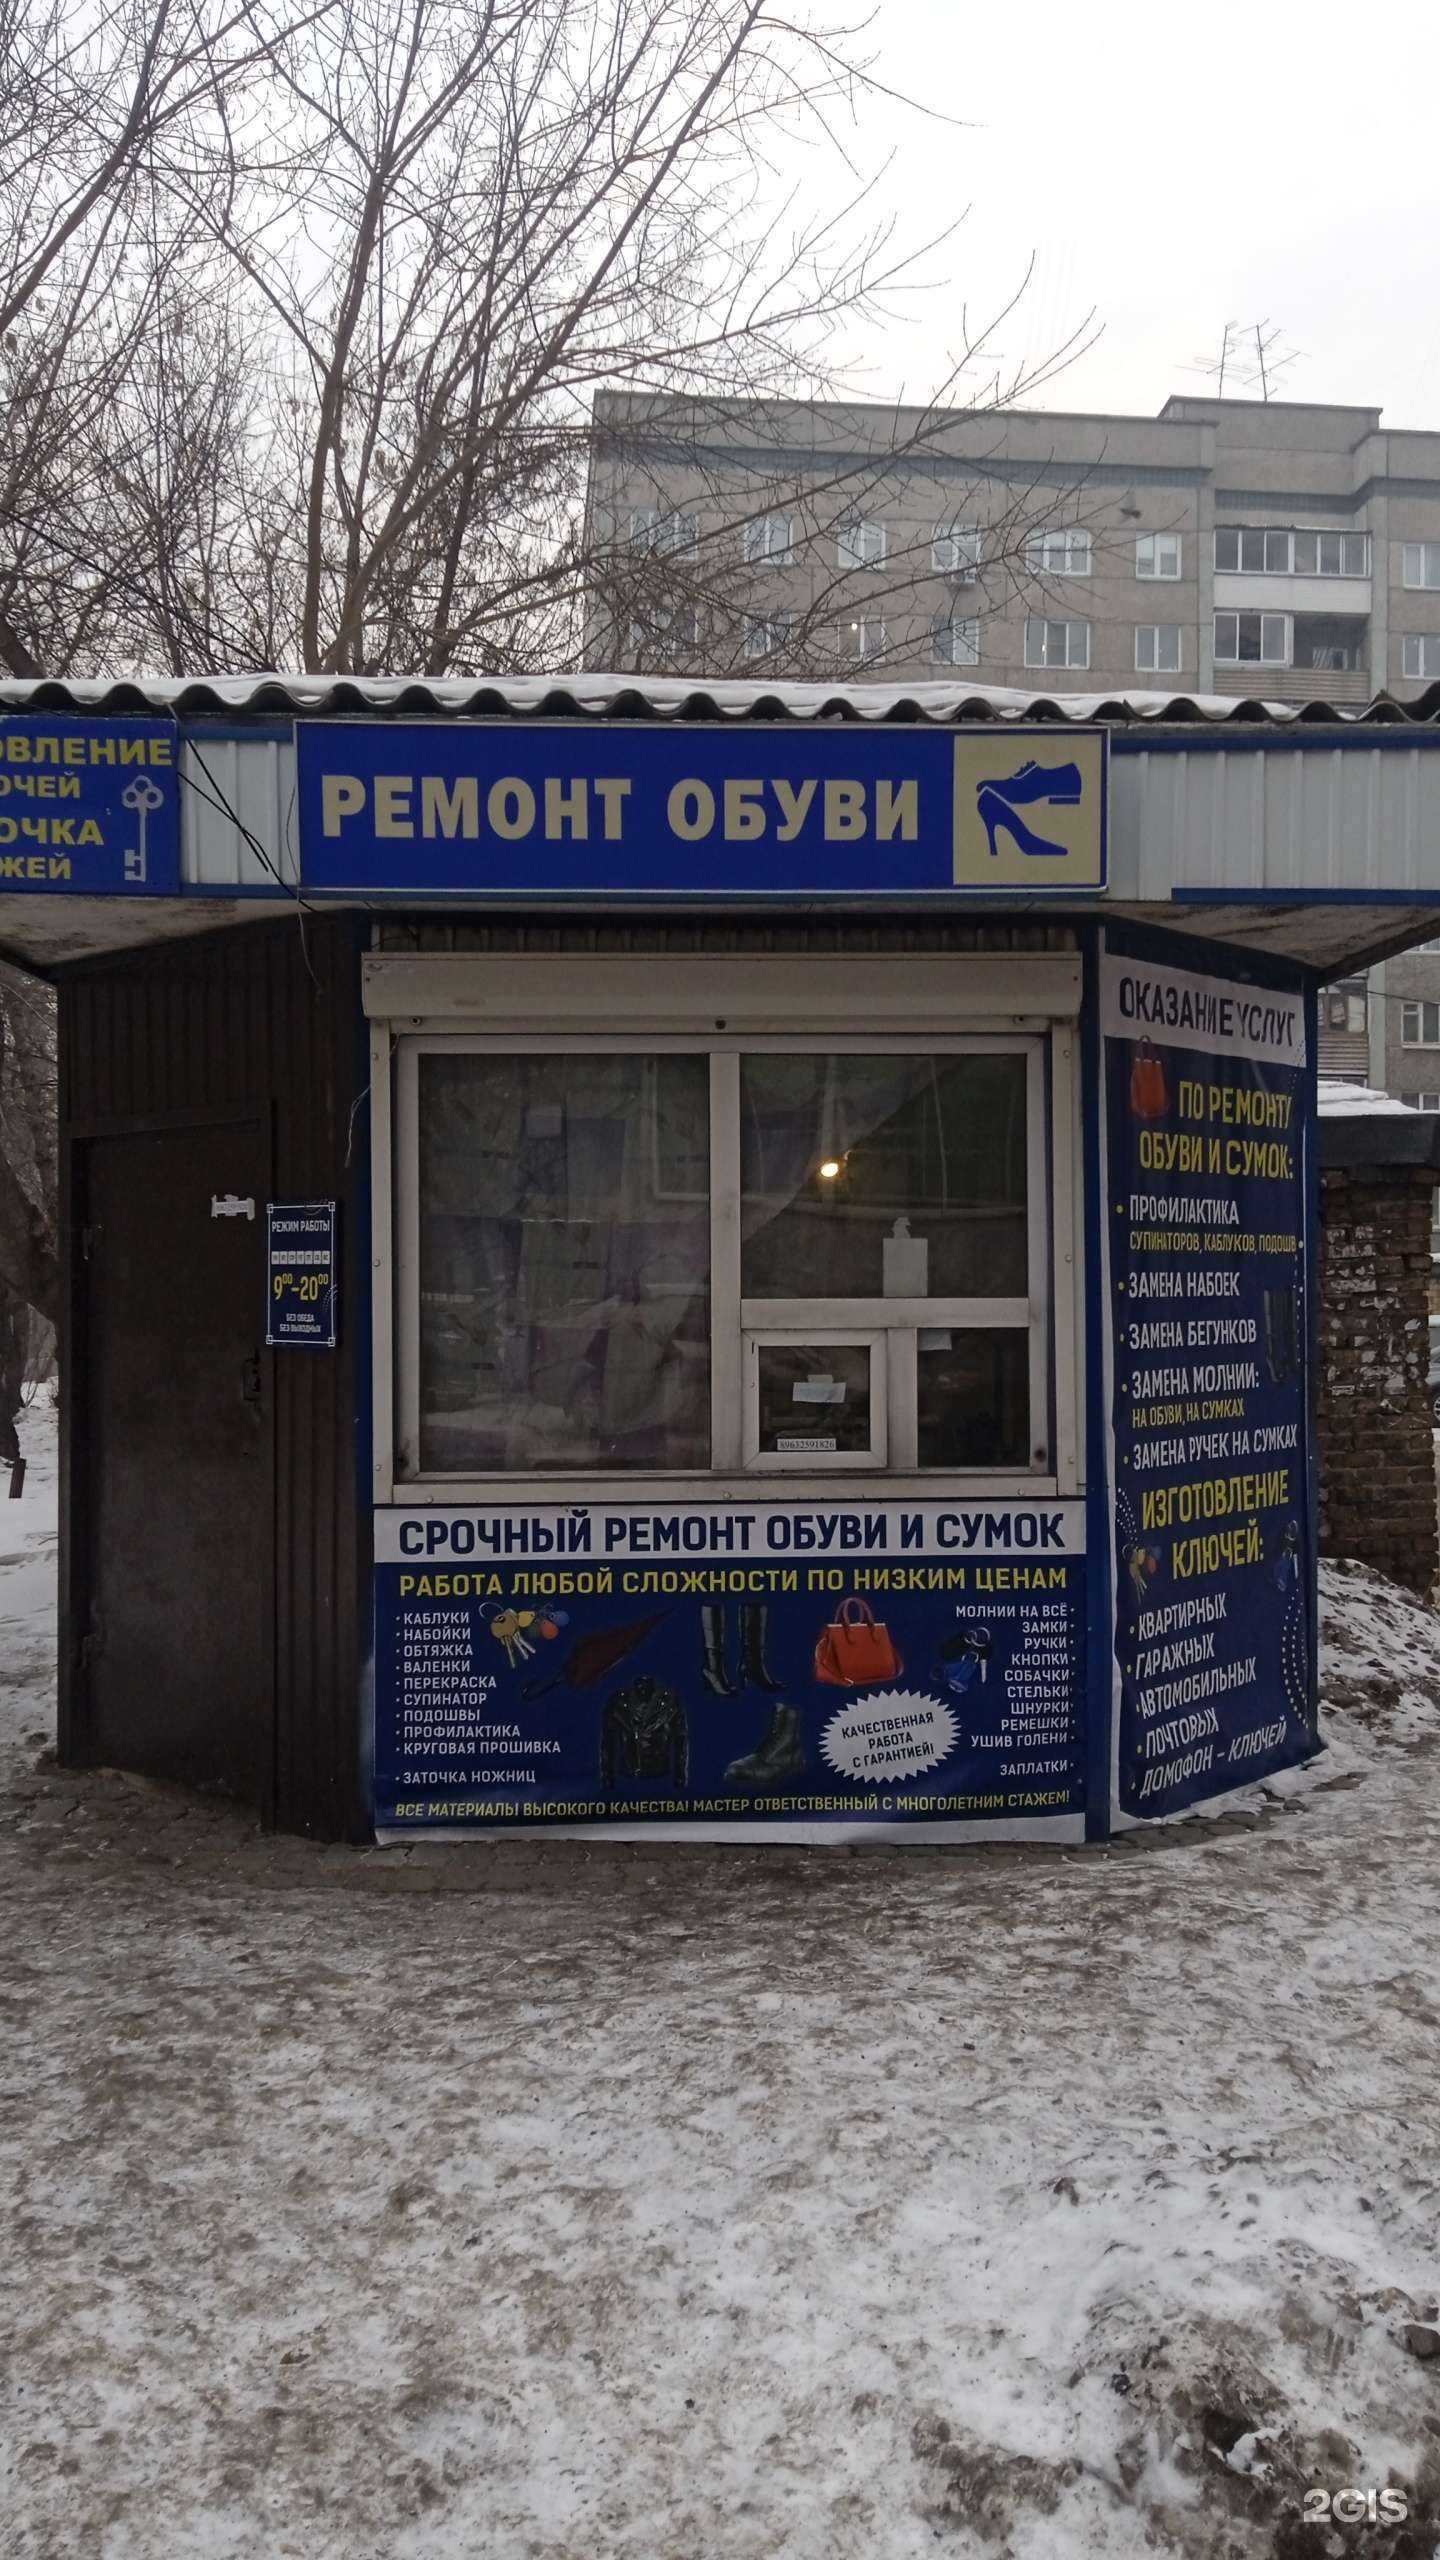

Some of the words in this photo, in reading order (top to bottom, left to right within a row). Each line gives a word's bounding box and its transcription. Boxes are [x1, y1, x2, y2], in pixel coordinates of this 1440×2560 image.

[0, 736, 172, 766] ВЛЕНИЕ
[321, 774, 631, 841] РЕМОНТ
[667, 778, 919, 842] ОБУВИ
[1120, 977, 1233, 1036] ОКАЗАНИЕ
[1236, 1003, 1295, 1047] УСЛУГ
[1179, 1081, 1203, 1119] ПО
[1209, 1084, 1292, 1129] РЕМОНТУ
[1139, 1130, 1203, 1174] ОБУВИ
[1209, 1138, 1221, 1175] И
[1226, 1139, 1294, 1179] СУМОК:
[1129, 1195, 1239, 1225] ПРОФИЛАКТИКА
[272, 1221, 299, 1232] РЕЖИМ
[300, 1220, 330, 1232] РАБОТЫ
[1130, 1231, 1202, 1254] СУПИНАТОРОВ,
[1259, 1235, 1297, 1253] ПОДОШВ
[1128, 1272, 1183, 1298] ЗАМЕНА
[1187, 1271, 1240, 1297] НАБОЕК
[1129, 1322, 1184, 1350] ЗАМЕНА
[1187, 1319, 1257, 1346] БЕГУНКОВ
[1132, 1367, 1189, 1399] ЗАМЕНА
[1193, 1362, 1260, 1392] МОЛНИИ:
[1132, 1408, 1147, 1429] НА
[1151, 1403, 1186, 1427] ОБУВИ,
[1186, 1402, 1200, 1422] НА
[1202, 1398, 1245, 1420] СУМКАХ
[1133, 1438, 1186, 1470] ЗАМЕНА
[1189, 1434, 1229, 1462] РУЧЕК
[1232, 1431, 1249, 1456] НА
[1253, 1424, 1298, 1454] СУМКАХ
[1142, 1469, 1289, 1530] ИЗГОТОВЛЕНИЕ
[399, 1509, 592, 1555] СРОЧНЫЙ
[605, 1515, 756, 1553] РЕМОНТ
[766, 1514, 887, 1551] ОБУВИ
[901, 1513, 923, 1549] И
[936, 1512, 1066, 1548] СУМОК
[1172, 1518, 1264, 1580] КЛЮЧЕЙ:
[400, 1574, 503, 1597] РАБОТА
[511, 1567, 613, 1595] ЛЮБОЙ
[623, 1569, 797, 1594] СЛОЖНОСТИ
[808, 1569, 843, 1591] ПО
[854, 1568, 965, 1590] НИЗКИМ
[976, 1567, 1067, 1592] ЦЕНАМ
[404, 1612, 470, 1625] КАБЛУКИ
[956, 1606, 1016, 1618] МОЛНИИ
[1020, 1605, 1039, 1617] НА
[1042, 1601, 1067, 1617] ВСЁ
[1138, 1592, 1227, 1641] КВАРТИРНЫХ
[404, 1626, 471, 1641] НАБОЙКИ
[1022, 1621, 1067, 1634] ЗАМКИ
[404, 1644, 473, 1657] ОБТЯЖКА
[1024, 1637, 1067, 1650] РУЧКИ
[1136, 1632, 1215, 1680] ГАРАЖНЫХ
[404, 1660, 471, 1673] ВАЛЕНКИ
[1011, 1653, 1068, 1666] КНОПКИ
[404, 1676, 497, 1689] ПЕРЕКРАСКА
[1004, 1669, 1069, 1683] СОБАЧКИ
[1140, 1656, 1256, 1720] АВТОМОБИЛЬНЫХ
[404, 1693, 487, 1706] СУПИНАТОР
[1007, 1685, 1069, 1699] СТЕЛЬКИ
[404, 1709, 480, 1724] ПОДОШВЫ
[1011, 1702, 1069, 1715] ШНУРКИ
[404, 1725, 520, 1739] ПРОФИЛАКТИКА
[842, 1712, 934, 1739] КАЧЕСТВЕННАЯ
[1001, 1717, 1069, 1731] РЕМЕШКИ
[1145, 1707, 1219, 1759] ПОЧТОВЫХ
[404, 1742, 475, 1755] КРУГОВАЯ
[480, 1740, 561, 1754] ПРОШИВКА
[868, 1732, 914, 1749] РАБОТА
[971, 1734, 1013, 1748] УШИВ
[1017, 1732, 1067, 1747] ГОЛЕНИ
[853, 1757, 861, 1768] С
[863, 1741, 935, 1767] ГАРАНТИЕЙ!
[1139, 1744, 1214, 1799] ДОМОФОН
[1228, 1715, 1288, 1763] КЛЮЧЕЙ
[403, 1771, 467, 1784] ЗАТОЧКА
[471, 1770, 536, 1784] НОЖНИЦ
[1000, 1761, 1068, 1776] ЗАПЛАТКИ
[395, 1803, 424, 1817] ВСЕ
[428, 1802, 519, 1816] МАТЕРИАЛЫ
[523, 1802, 606, 1816] ВЫСОКОГО
[694, 1799, 750, 1813] МАСТЕР
[754, 1794, 878, 1811] ОТВЕТСТВЕННЫЙ
[882, 1797, 892, 1810] С
[896, 1794, 1004, 1811] МНОГОЛЕТНИМ
[1008, 1790, 1070, 1808] СТАЖЕМ!
